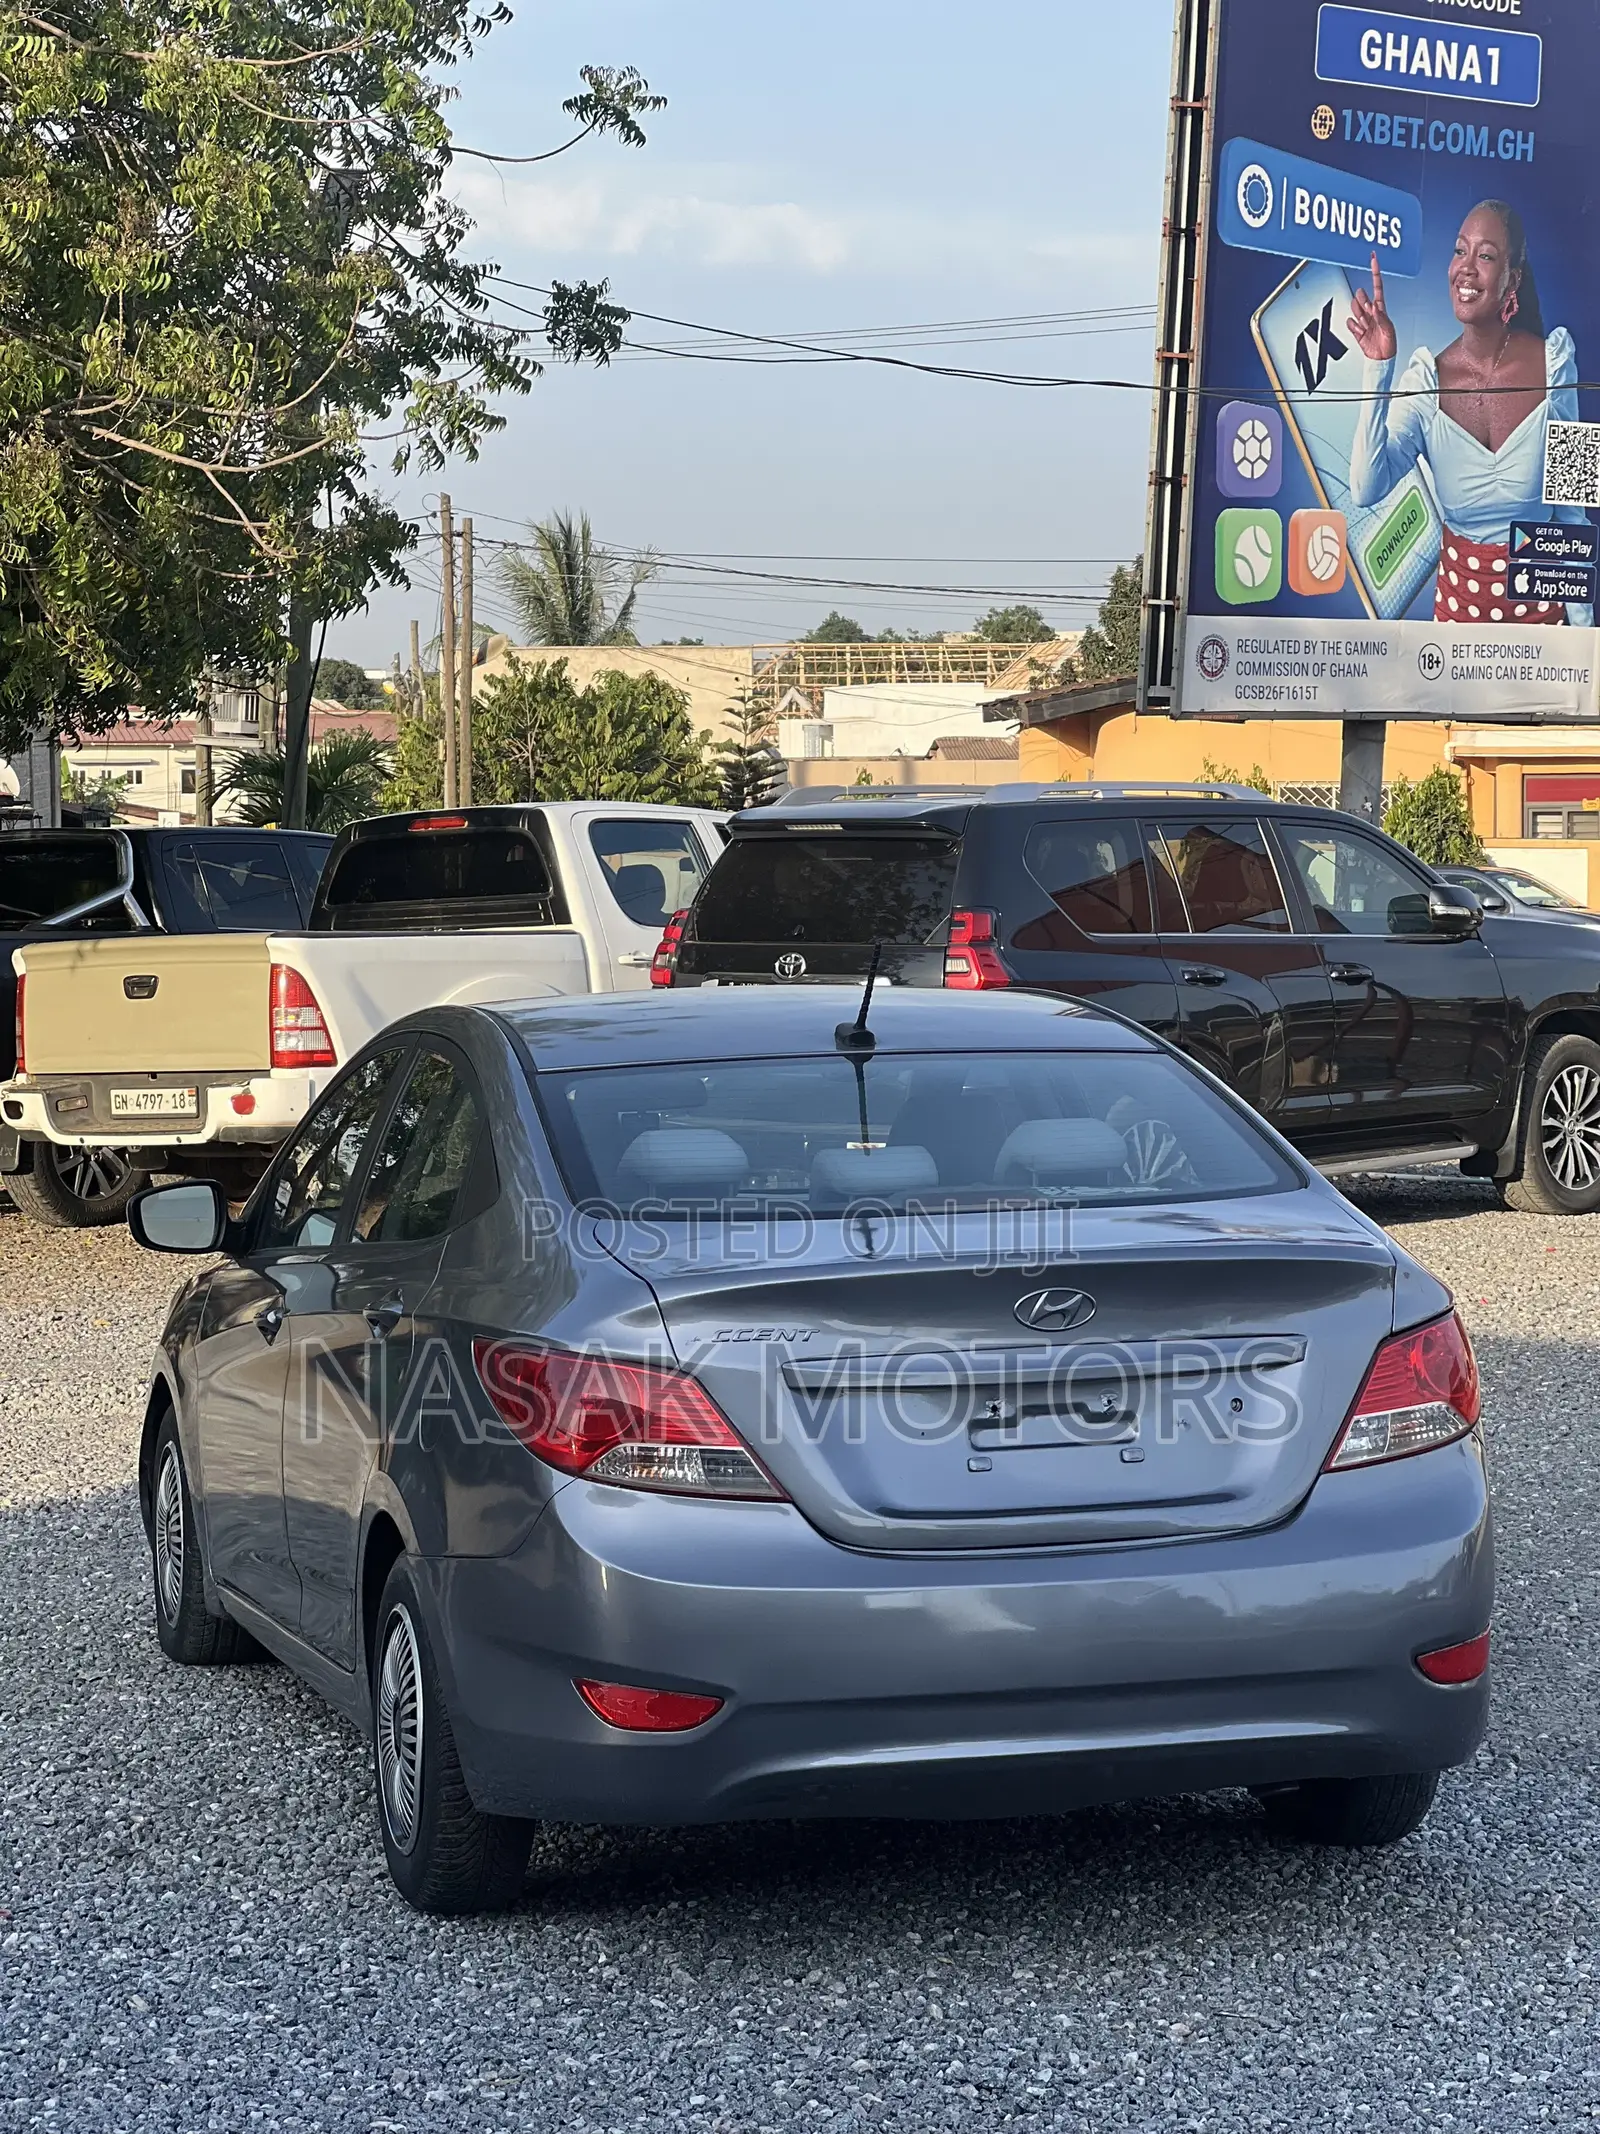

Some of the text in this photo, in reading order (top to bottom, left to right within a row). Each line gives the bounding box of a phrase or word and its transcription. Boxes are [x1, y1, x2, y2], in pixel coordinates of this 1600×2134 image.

[1360, 29, 1500, 86] GHANA1
[1341, 108, 1535, 162] 1XBET.COM.GH
[1294, 187, 1402, 249] BONUSES
[1376, 509, 1418, 569] DOWNLOAD
[1535, 527, 1547, 535] GET
[1553, 528, 1563, 536] ON
[1535, 537, 1593, 557] Google Play
[1534, 568, 1566, 578] Download
[1577, 571, 1588, 579] the
[1533, 580, 1588, 598] App Store
[1236, 638, 1388, 656] REGULATED BY THE GAMING
[1451, 644, 1542, 659] BET RESPONSIBLY
[1236, 661, 1368, 678] COMMISSION OF GHANA
[1421, 653, 1442, 670] 18+
[1451, 665, 1589, 683] GAMING CAN BE ADDICTIVE
[1235, 684, 1319, 700] GCSB26F1615T
[114, 1094, 128, 1110] GN
